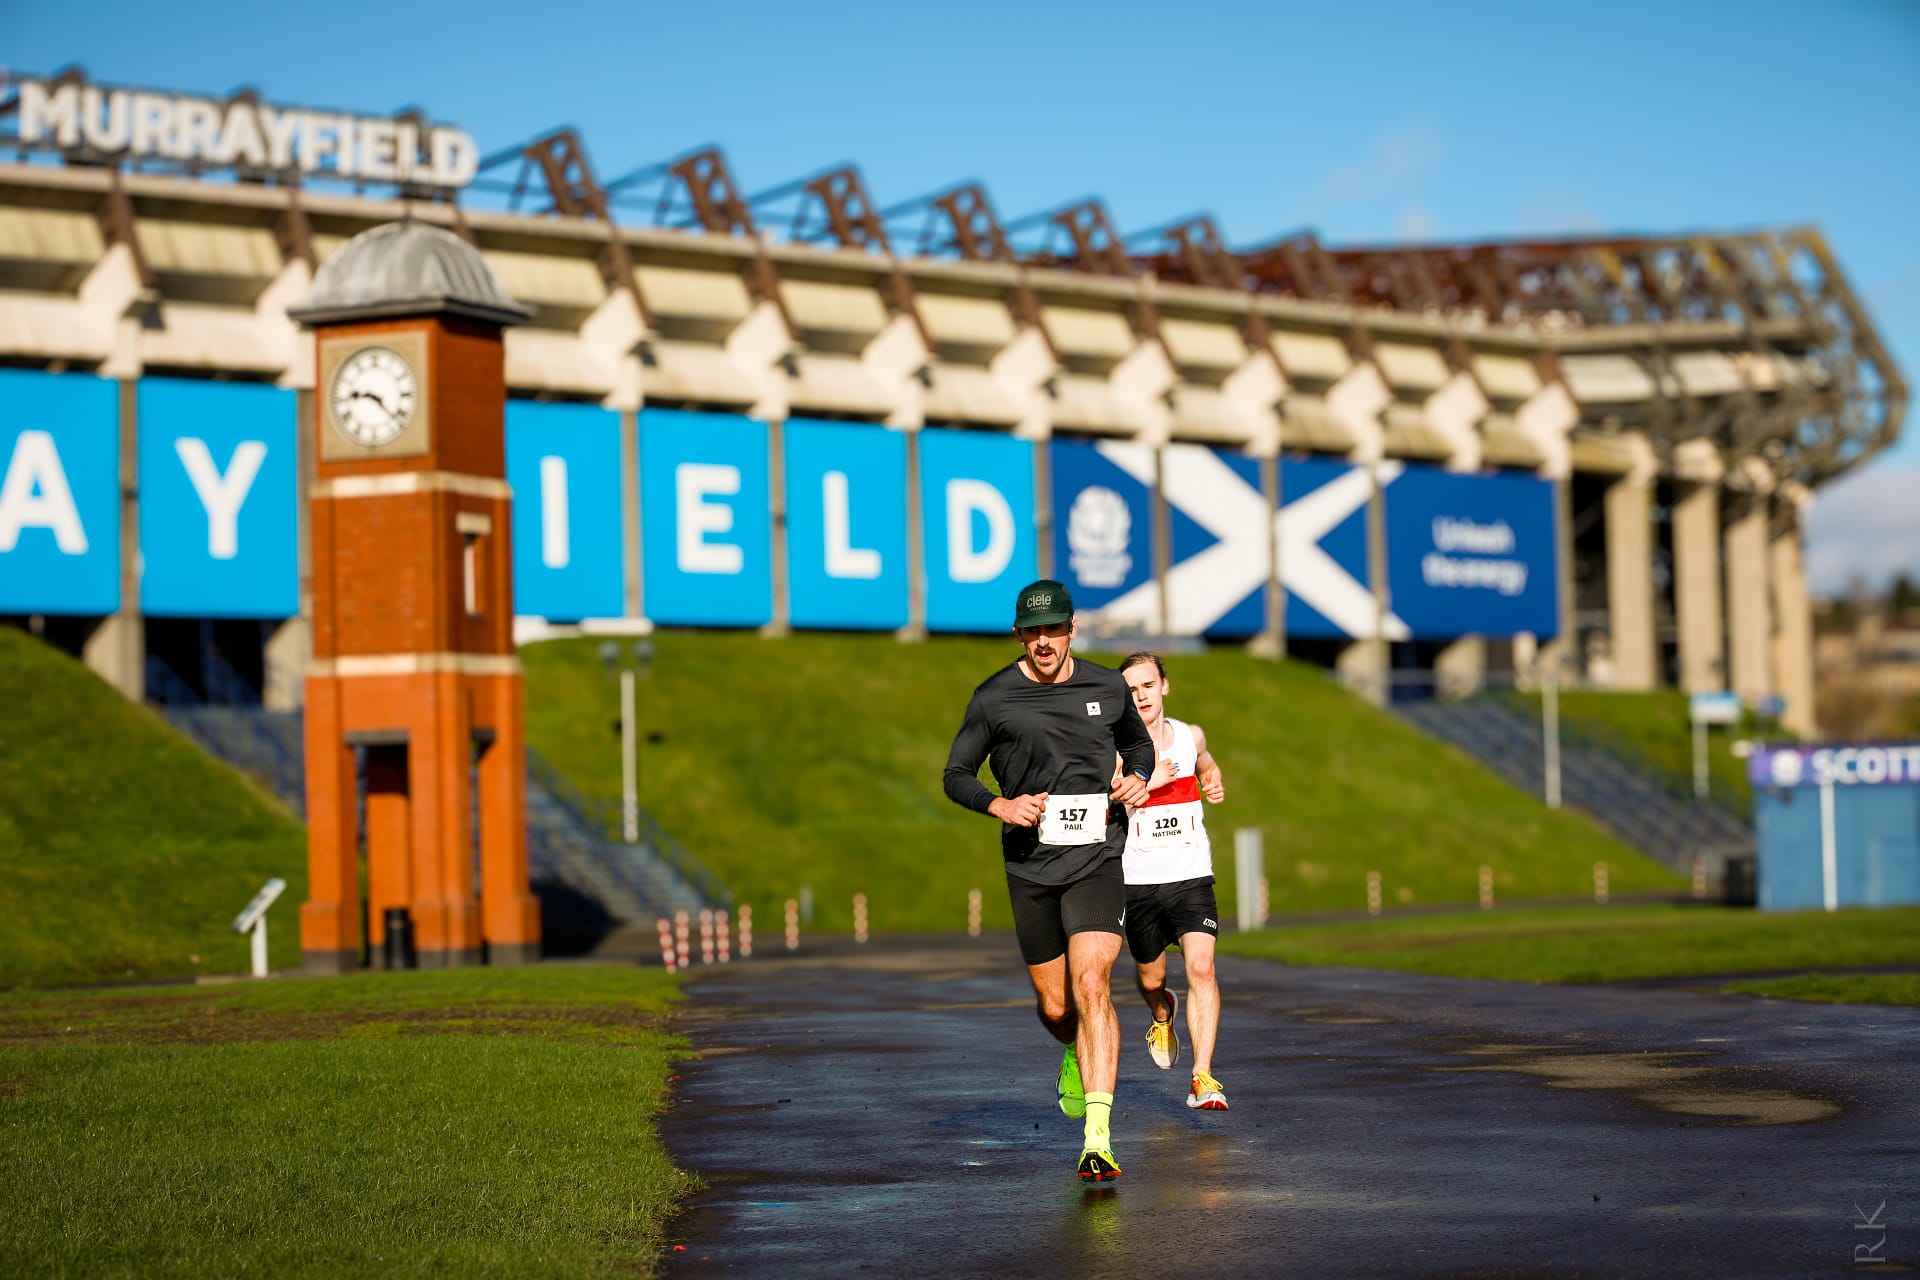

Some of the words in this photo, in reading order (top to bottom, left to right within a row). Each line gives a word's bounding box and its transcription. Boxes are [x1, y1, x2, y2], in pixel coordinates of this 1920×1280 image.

[17, 79, 480, 189] MURRAYFIELD
[1026, 593, 1052, 608] ciele
[1059, 808, 1088, 822] 157
[1064, 823, 1084, 831] PAUL
[1154, 817, 1178, 829] 120
[1152, 829, 1182, 838] MATTHEW
